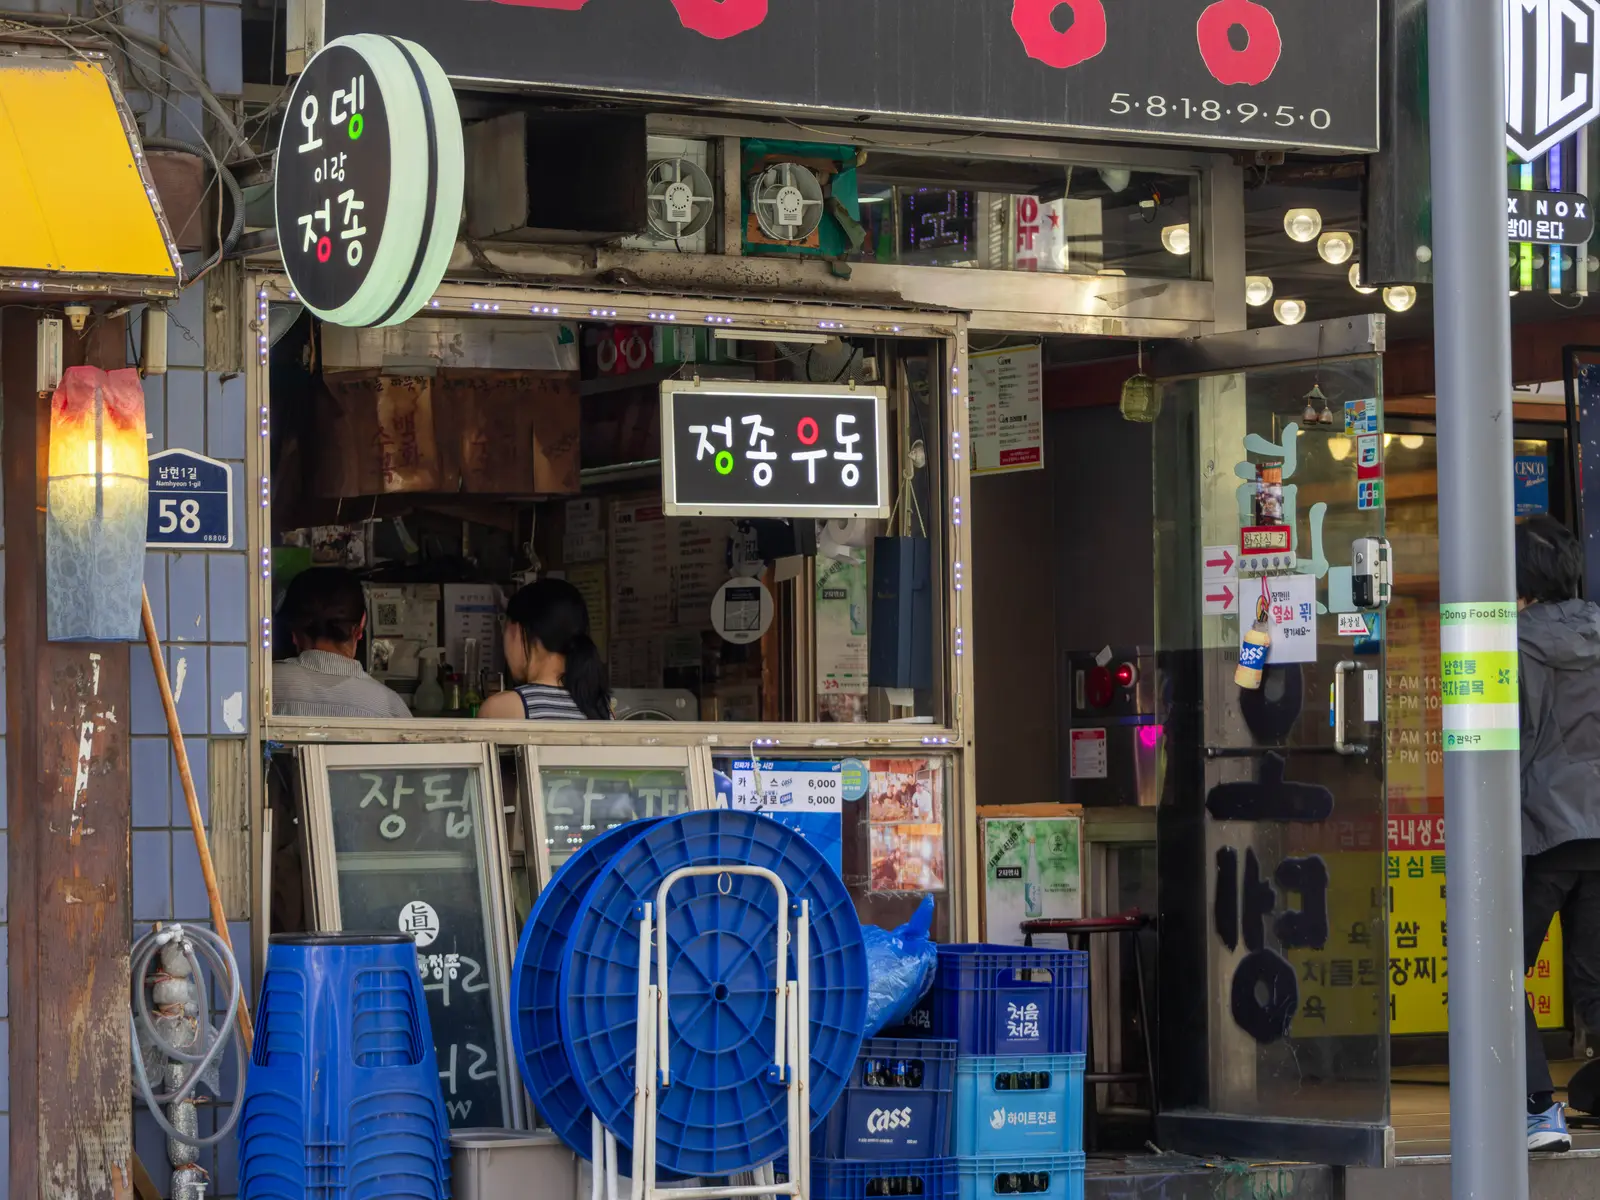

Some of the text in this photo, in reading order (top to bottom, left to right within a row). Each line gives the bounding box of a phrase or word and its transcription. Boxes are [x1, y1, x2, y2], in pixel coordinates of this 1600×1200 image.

[297, 75, 366, 154] 오뎅
[314, 151, 348, 184] 이랑
[297, 189, 367, 267] 정종
[1535, 221, 1565, 240] 온다
[688, 413, 864, 487] 정종 우동
[158, 466, 197, 480] 남현1길
[1514, 460, 1545, 476] CESCO
[156, 480, 201, 489] Namhyeon 1-gil
[1360, 487, 1381, 501] JCB
[158, 499, 200, 534] 58
[203, 534, 227, 542] 08806
[1272, 604, 1294, 625] 열쇠
[1469, 608, 1496, 619] Food
[1339, 616, 1361, 629] 화장실
[1444, 660, 1477, 675] 남현동
[1399, 675, 1419, 689] AM
[1399, 695, 1418, 709] PM
[1400, 730, 1420, 744] AM
[1456, 735, 1482, 744] 관악구
[1400, 750, 1419, 764] PM
[808, 779, 836, 790] 6,000
[808, 795, 836, 806] 5,000
[1006, 1001, 1040, 1021] 처음
[1006, 1020, 1040, 1038] 처럼
[1007, 1111, 1057, 1125] 하이트진로
